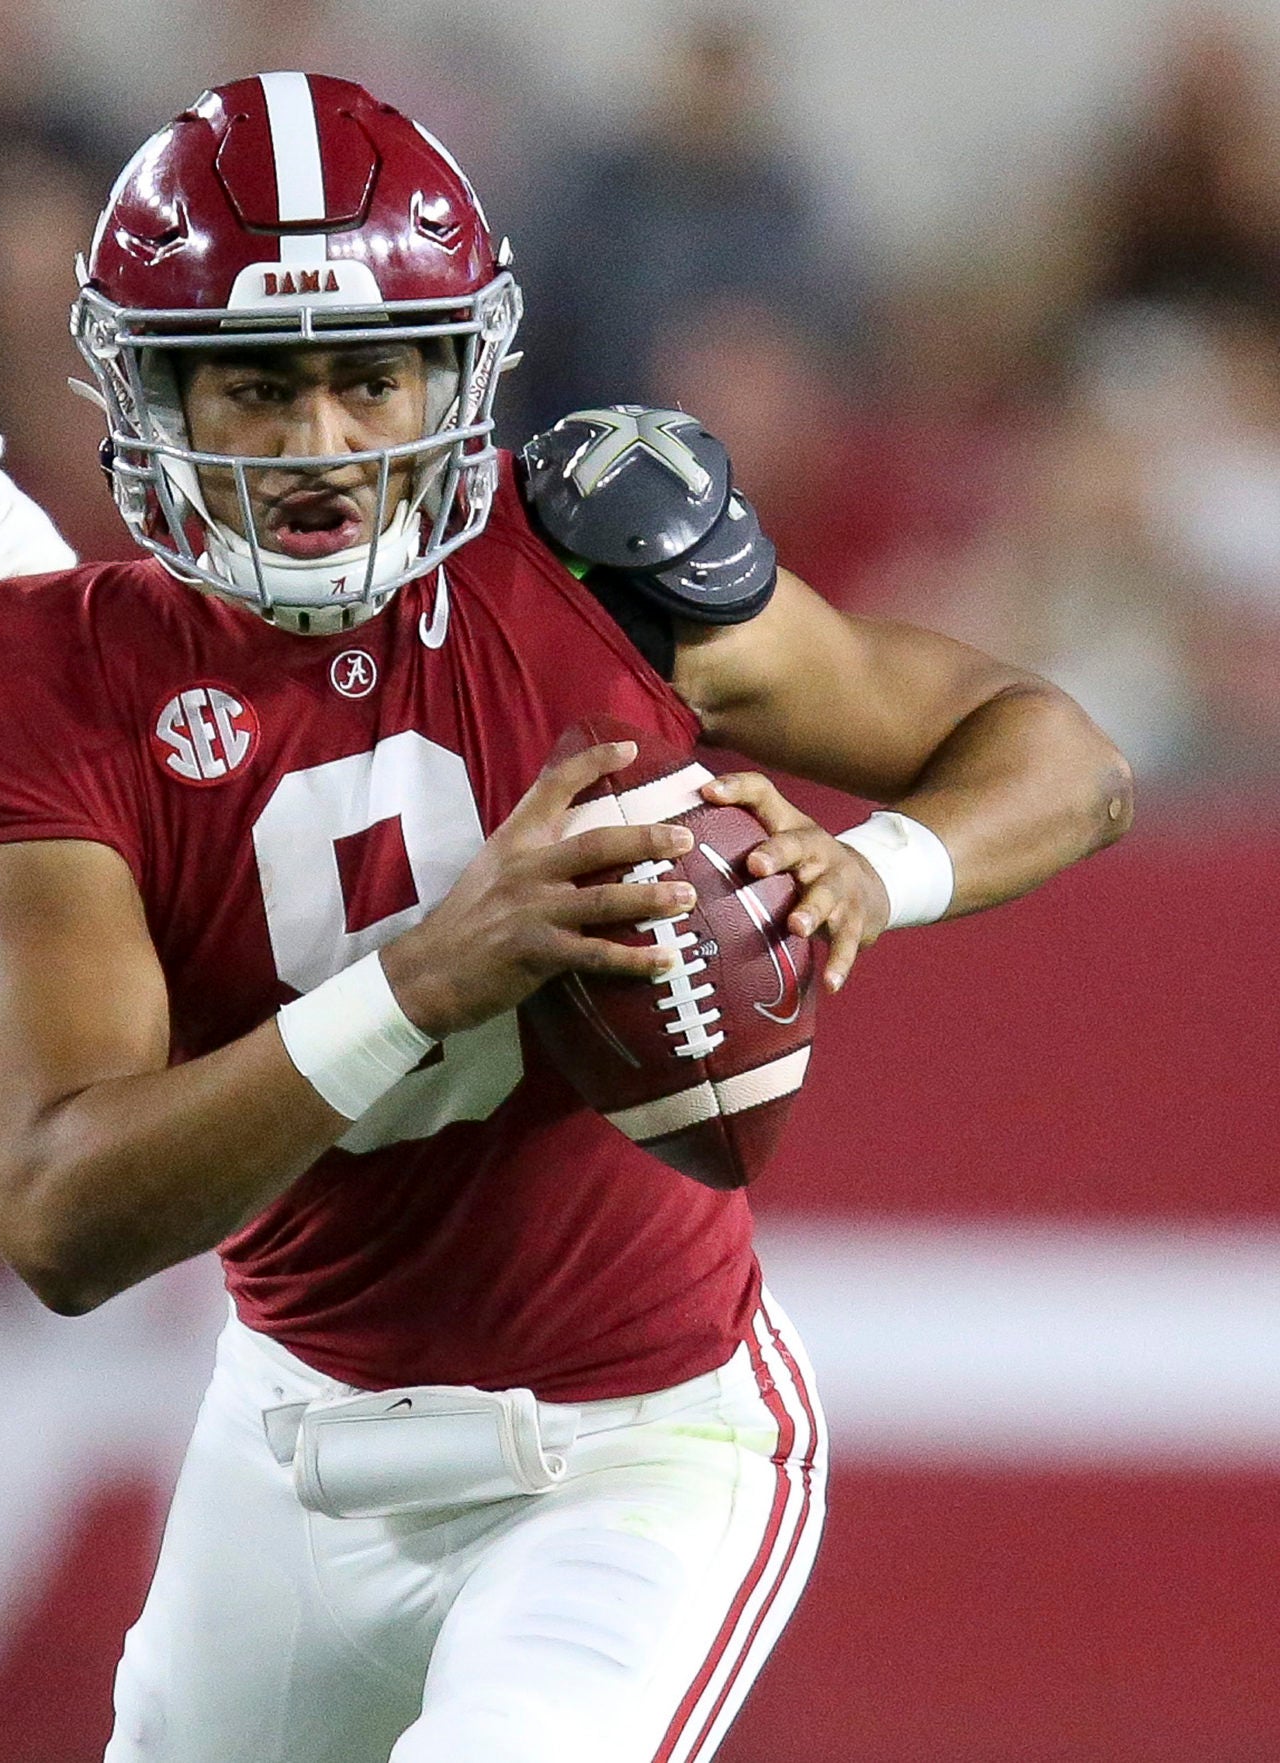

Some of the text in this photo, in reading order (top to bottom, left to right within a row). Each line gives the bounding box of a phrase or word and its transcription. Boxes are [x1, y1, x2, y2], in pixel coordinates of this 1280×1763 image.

[263, 269, 340, 296] BAMA
[340, 655, 369, 690] A
[156, 687, 250, 780] SEC
